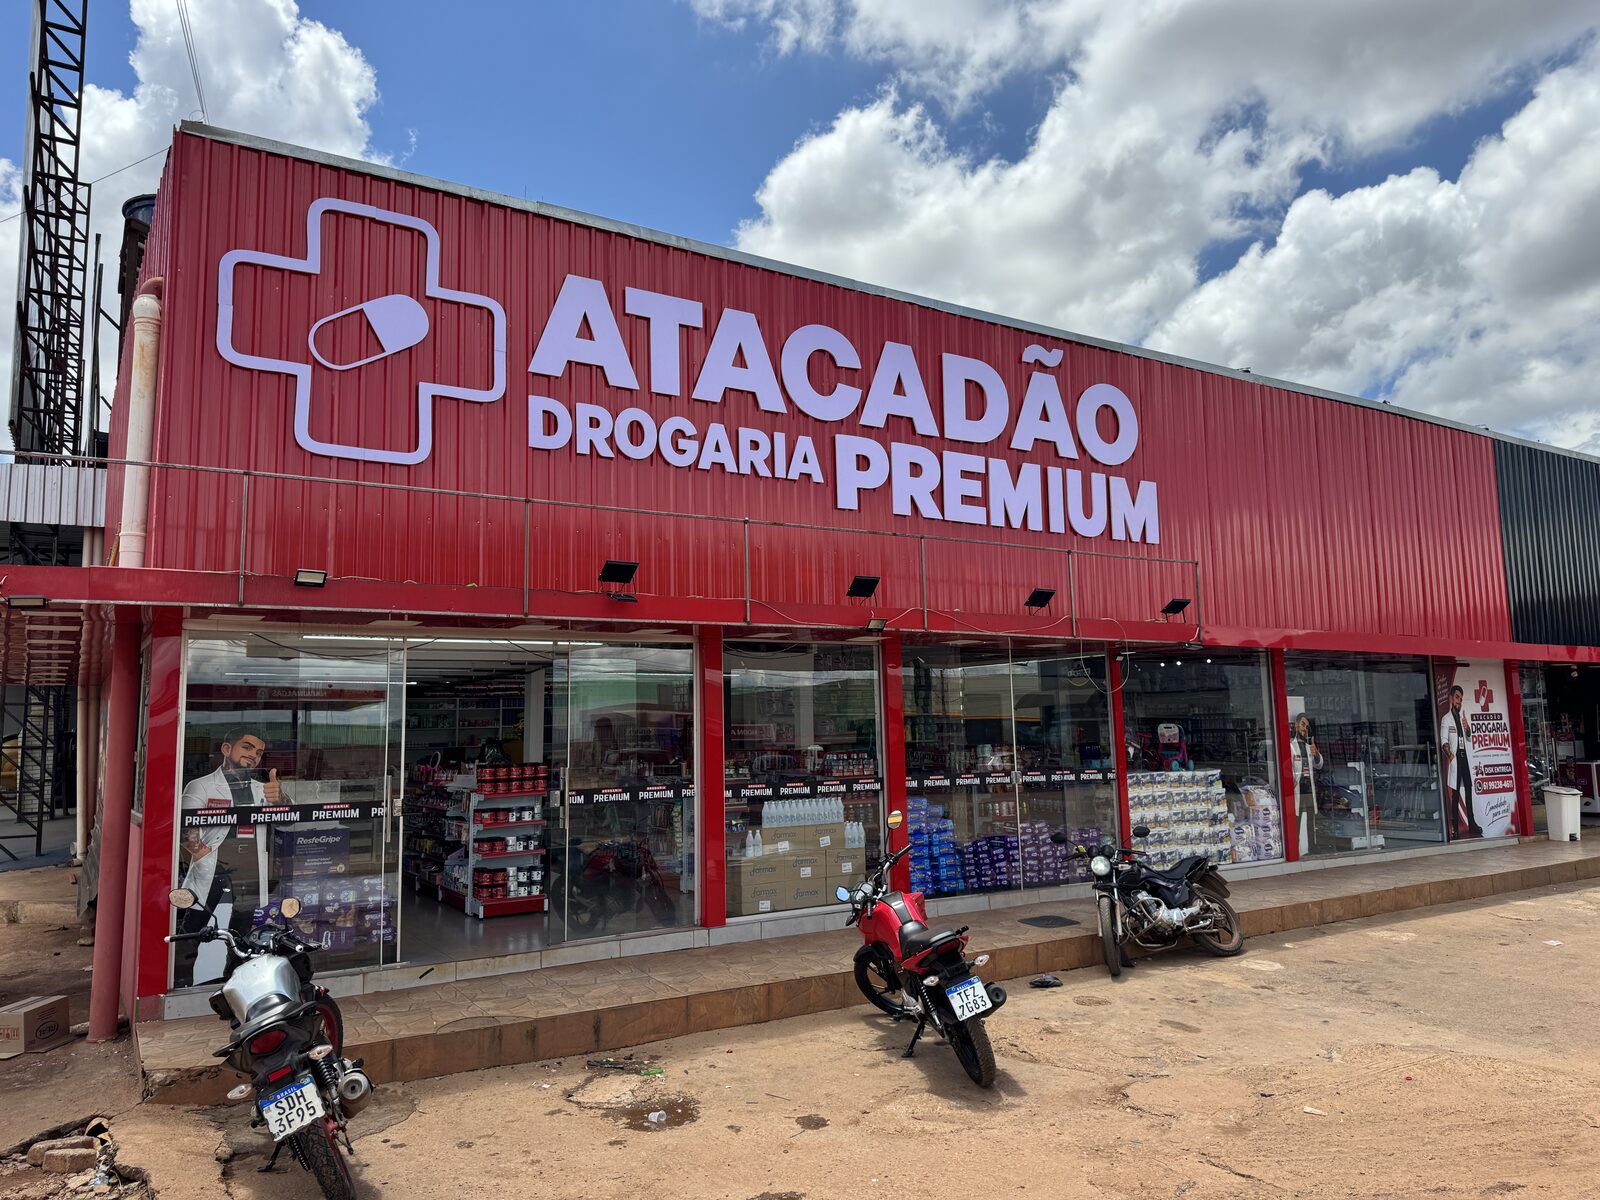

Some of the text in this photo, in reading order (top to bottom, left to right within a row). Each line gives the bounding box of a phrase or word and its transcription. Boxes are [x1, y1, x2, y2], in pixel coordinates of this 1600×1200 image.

[527, 273, 1139, 467] ATACADÃO
[528, 395, 1160, 546] DROGARIA PREMIUM
[1471, 722, 1508, 733] DROGARIA
[1472, 734, 1510, 750] PREMIUM
[853, 782, 881, 791] PREMIUM
[924, 779, 950, 787] PREMIUM
[956, 778, 980, 786] PREMIUM
[638, 790, 674, 800] PREMIUM
[741, 788, 773, 797] PREMIUM
[780, 787, 810, 796] PREMIUM
[817, 785, 847, 794] PREMIUM
[593, 792, 630, 803] PREMIUM
[185, 813, 237, 826] PREMIUM
[250, 811, 300, 823] PREMIUM
[312, 808, 360, 820] PREMIUM
[296, 835, 341, 845] ResfeGripe
[957, 986, 980, 1003] TFZ
[959, 996, 987, 1016] 7G83
[276, 1086, 298, 1099] BRASIL
[275, 1089, 307, 1116] SDH
[275, 1100, 317, 1133] 3F95
